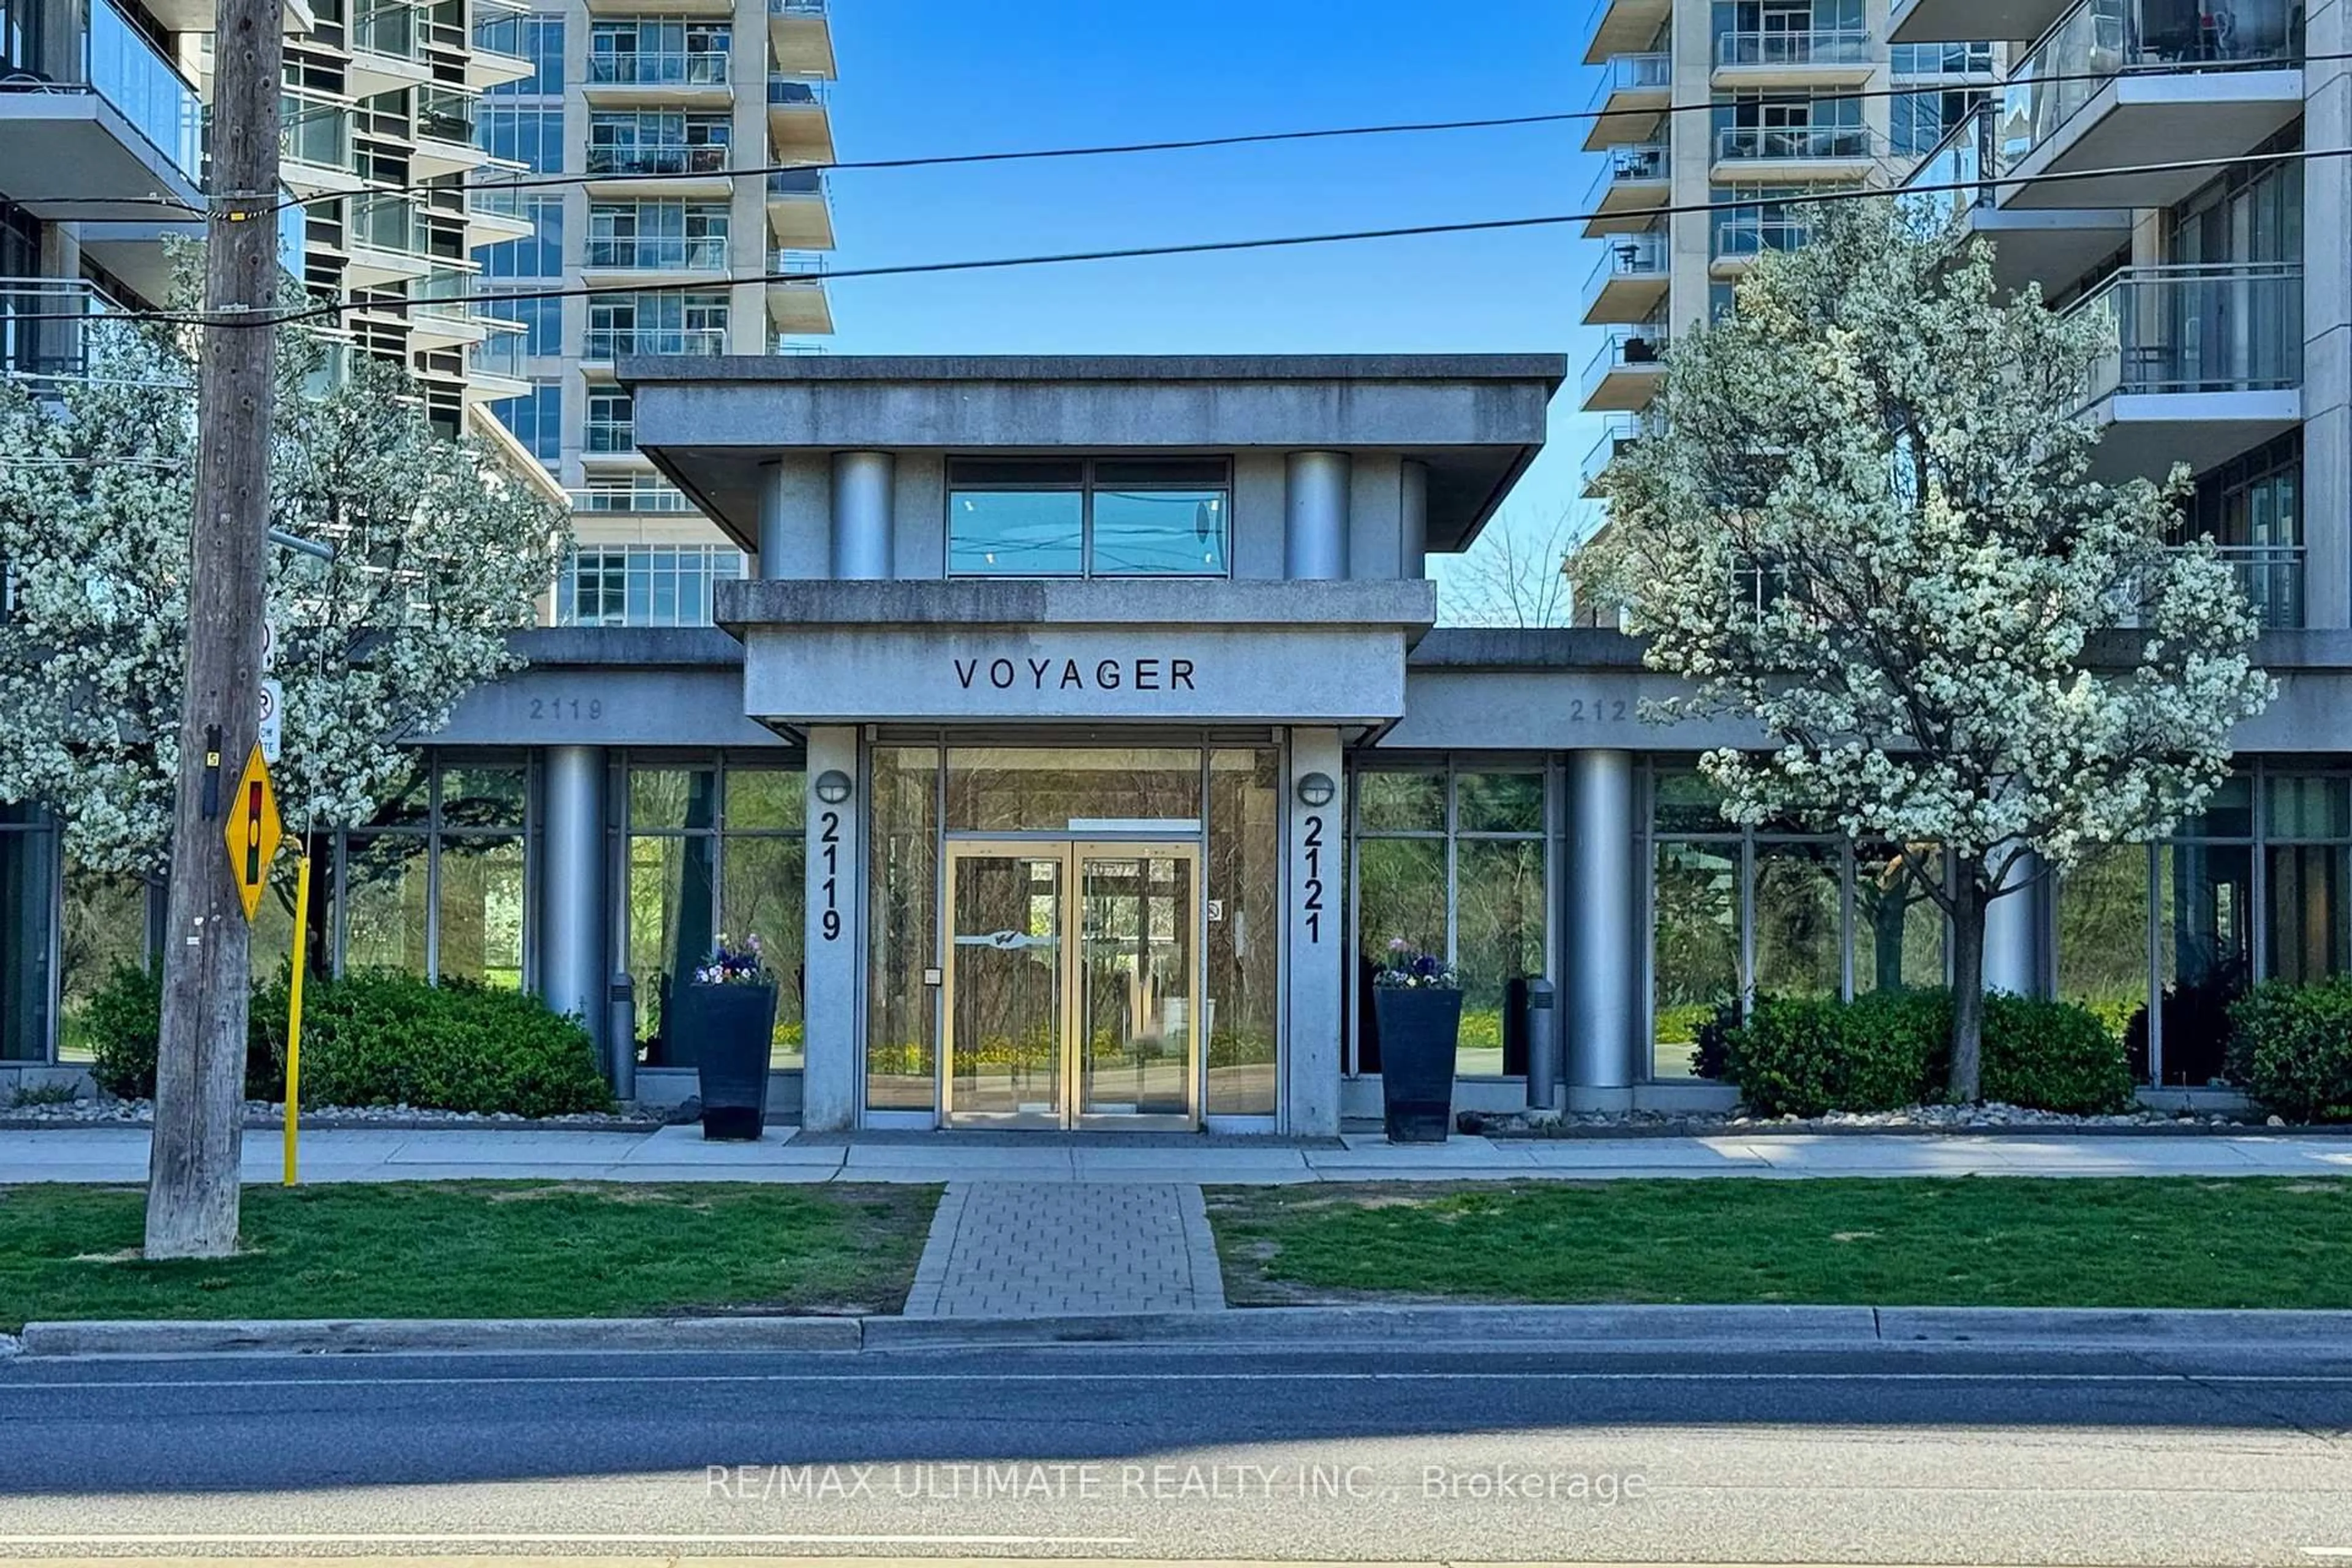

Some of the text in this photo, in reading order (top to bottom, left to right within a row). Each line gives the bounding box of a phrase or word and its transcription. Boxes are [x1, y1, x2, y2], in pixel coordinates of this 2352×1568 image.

[954, 658, 1195, 690] VOYAGER
[530, 698, 602, 720] 2119
[1570, 699, 1627, 722] 212
[821, 812, 841, 941] 2119
[1304, 816, 1323, 943] 2121
